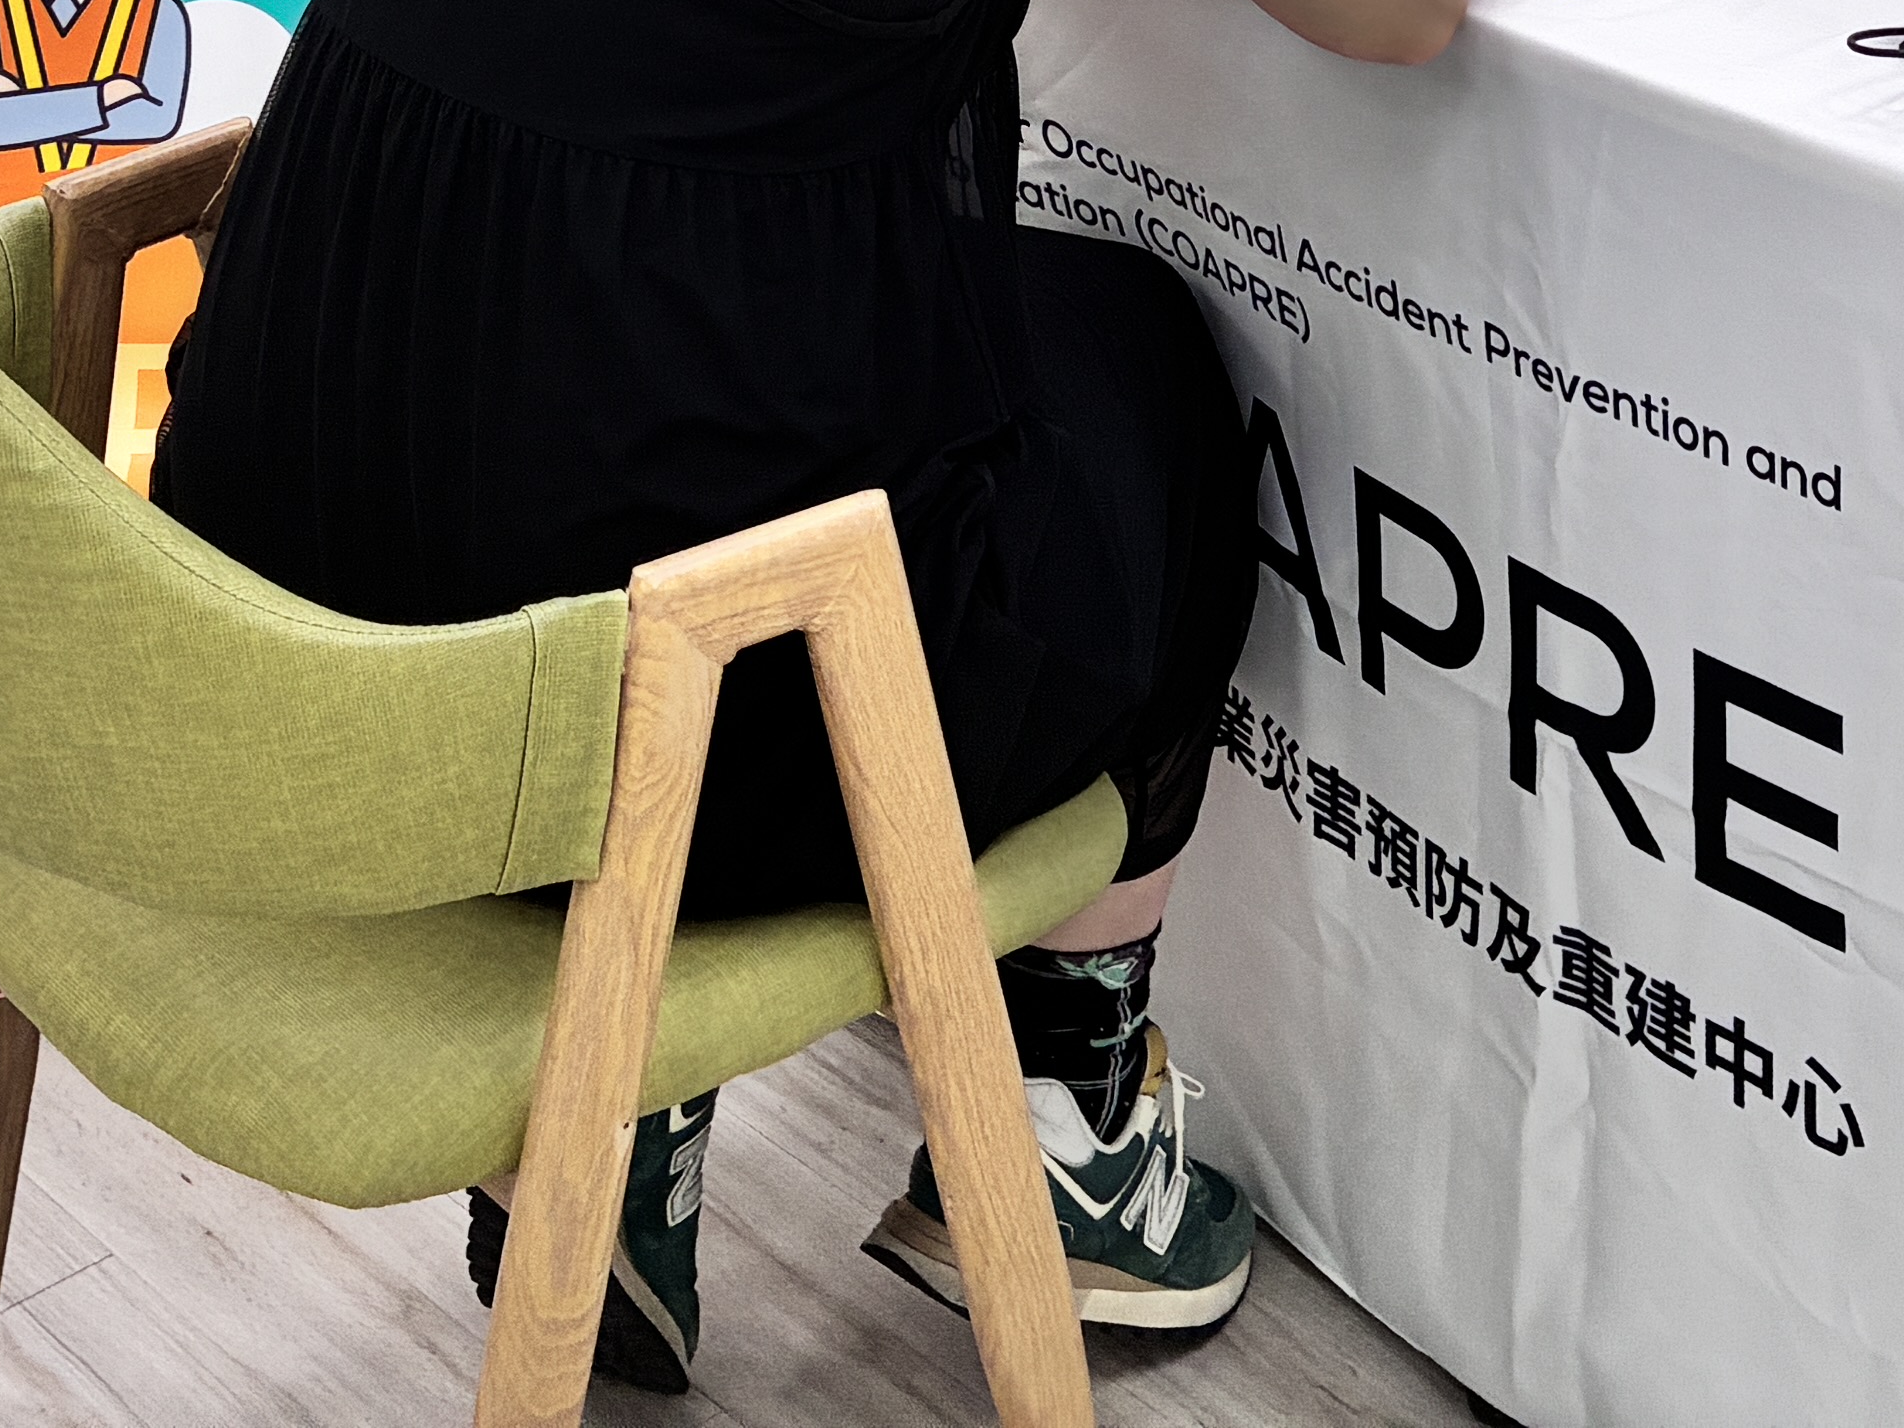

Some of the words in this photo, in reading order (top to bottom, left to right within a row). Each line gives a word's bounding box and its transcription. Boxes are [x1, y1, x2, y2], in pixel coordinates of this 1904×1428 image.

[1041, 118, 1286, 264] Occupational
[1296, 236, 1472, 355] Accident
[1483, 320, 1731, 469] Prevention
[1744, 438, 1844, 512] and
[1132, 208, 1312, 346] (COAPRE)
[1249, 394, 1848, 955] APRE
[1214, 684, 1866, 1158] 業災害預防及重建中心
